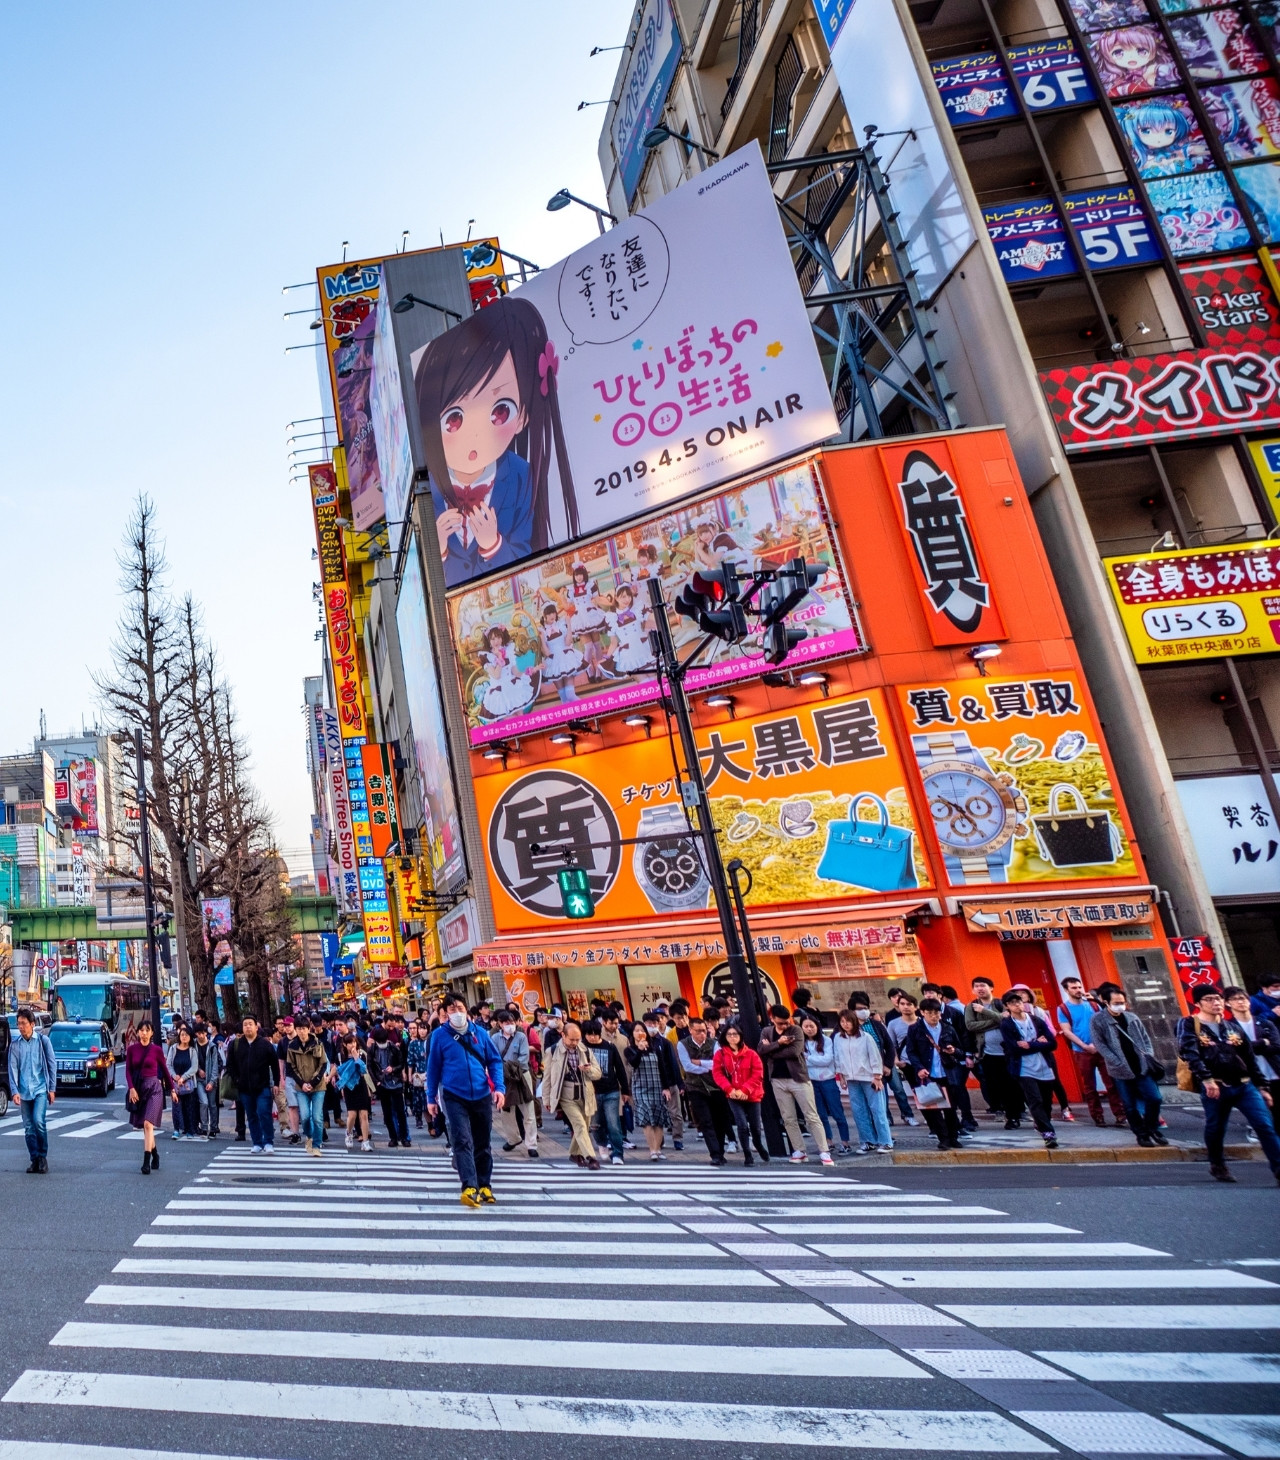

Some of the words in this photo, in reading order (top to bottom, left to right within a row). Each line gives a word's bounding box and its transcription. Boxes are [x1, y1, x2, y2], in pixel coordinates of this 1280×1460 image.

[828, 1, 846, 33] 5F
[945, 88, 1008, 110] AMENITY
[1023, 68, 1088, 107] 6F
[955, 96, 1005, 114] DREAM
[705, 161, 750, 192] KADOKAWA
[1163, 207, 1241, 239] 3.29
[999, 240, 1066, 263] AMENITY
[1082, 221, 1151, 263] 5F
[622, 235, 650, 293] 友達に
[1010, 250, 1063, 268] DREAM
[600, 253, 629, 322] なりたい
[1194, 291, 1262, 316] Poker
[1201, 303, 1272, 330] Stars
[593, 319, 759, 407] ひとりぼっちの
[594, 438, 698, 497] 2019.4.5
[705, 414, 748, 446] ON
[754, 393, 804, 430] AIR
[317, 506, 335, 514] DVD
[323, 531, 335, 539] CD
[898, 470, 989, 614] 質
[321, 548, 341, 556] アニメ
[323, 557, 341, 565] コミック
[793, 604, 827, 623] cafe
[1151, 609, 1236, 634] りらくる
[1147, 636, 1261, 659] 秋葉原中央通り店
[324, 712, 341, 752] AKKY
[698, 698, 887, 793] 大黒屋
[332, 767, 348, 830] Tax-free
[368, 774, 387, 825] 吉野家
[385, 774, 396, 823] YOSHINOYA
[1222, 804, 1271, 829] 喫茶
[340, 832, 353, 870] Shop
[502, 784, 613, 902] 質
[362, 878, 384, 888] DVD
[1004, 902, 1150, 926] 1階にて高価買取中
[369, 936, 391, 944] AKIBA
[476, 954, 522, 968] 高価買取
[826, 925, 903, 949] 無料査定
[1178, 940, 1203, 957] 4F
[640, 992, 672, 1004] 大黒屋
